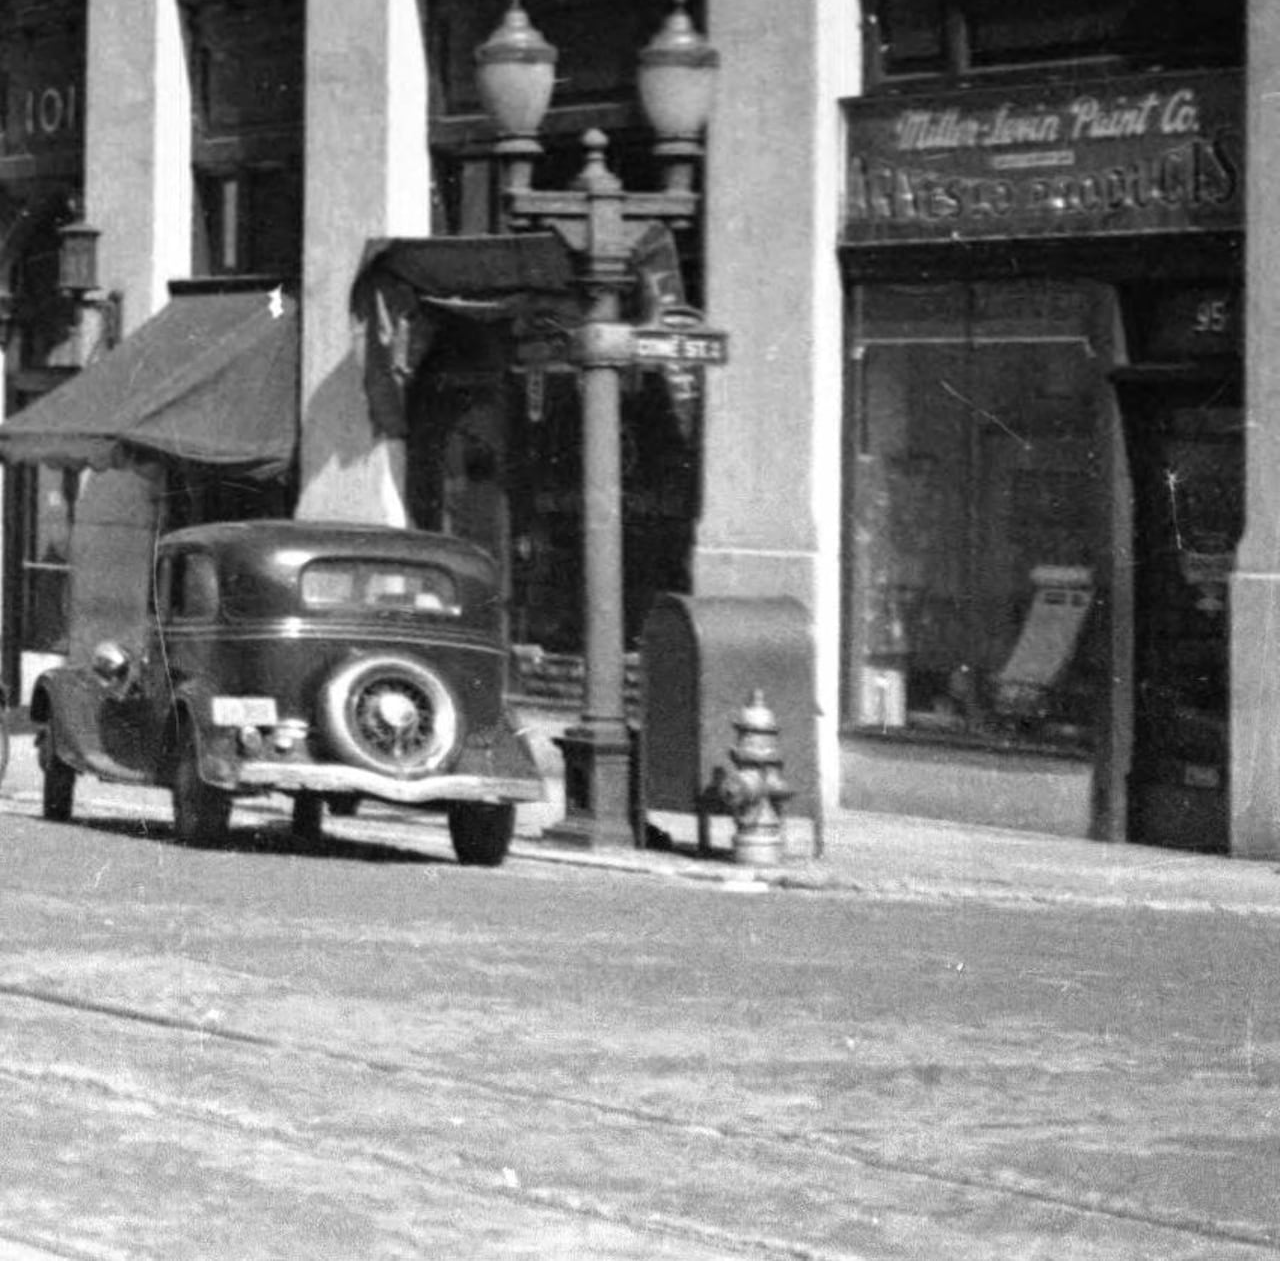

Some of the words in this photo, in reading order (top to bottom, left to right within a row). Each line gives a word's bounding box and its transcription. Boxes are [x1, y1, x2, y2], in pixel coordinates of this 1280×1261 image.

[25, 86, 76, 134] 101
[1070, 93, 1160, 139] Paint
[1161, 89, 1200, 133] Co.
